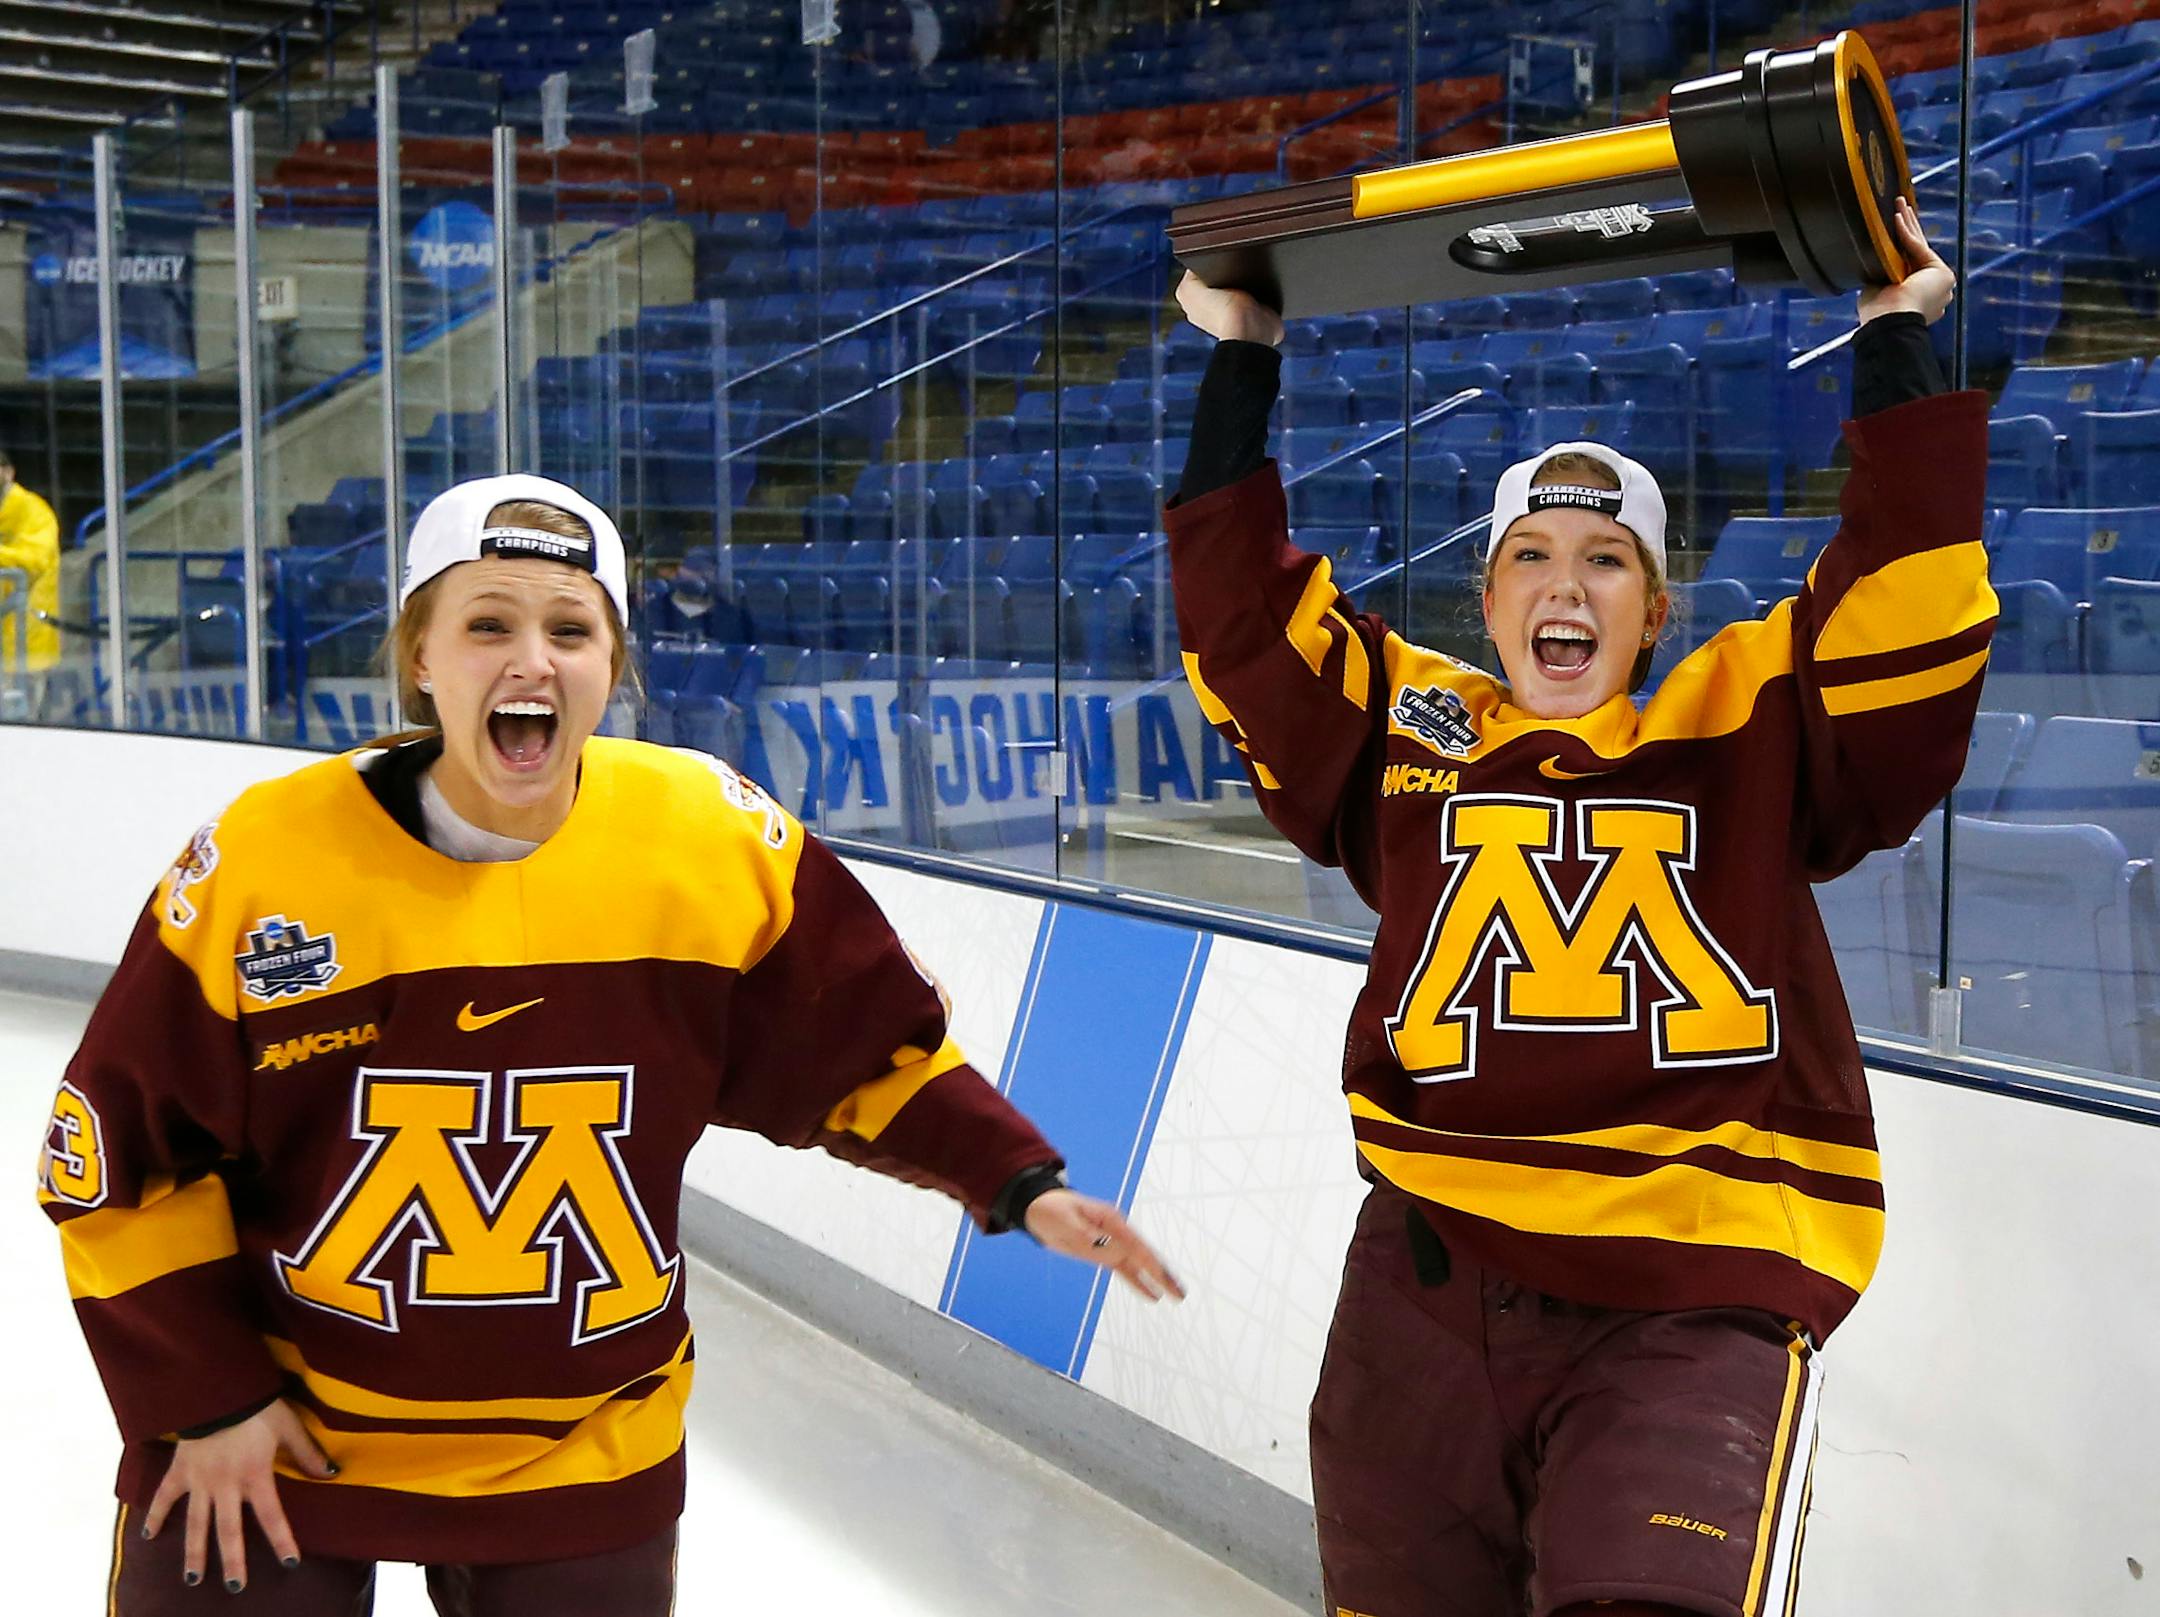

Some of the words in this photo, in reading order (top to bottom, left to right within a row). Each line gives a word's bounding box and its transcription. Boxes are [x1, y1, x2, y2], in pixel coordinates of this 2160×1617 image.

[65, 256, 99, 282] ICE
[114, 255, 187, 282] OCKEY
[1539, 493, 1602, 507] CHAMPIONS
[495, 537, 569, 557] CHAMPIONS
[1406, 695, 1448, 723] FROZEN
[1444, 719, 1473, 742] FOUR
[1382, 763, 1459, 797] WCHA
[1383, 792, 1780, 1084] M
[245, 953, 292, 973] FROZEN
[292, 945, 326, 965] FOUR
[40, 1079, 109, 1208] 3
[272, 1064, 681, 1346] M
[1648, 1513, 1728, 1542] BAUER
